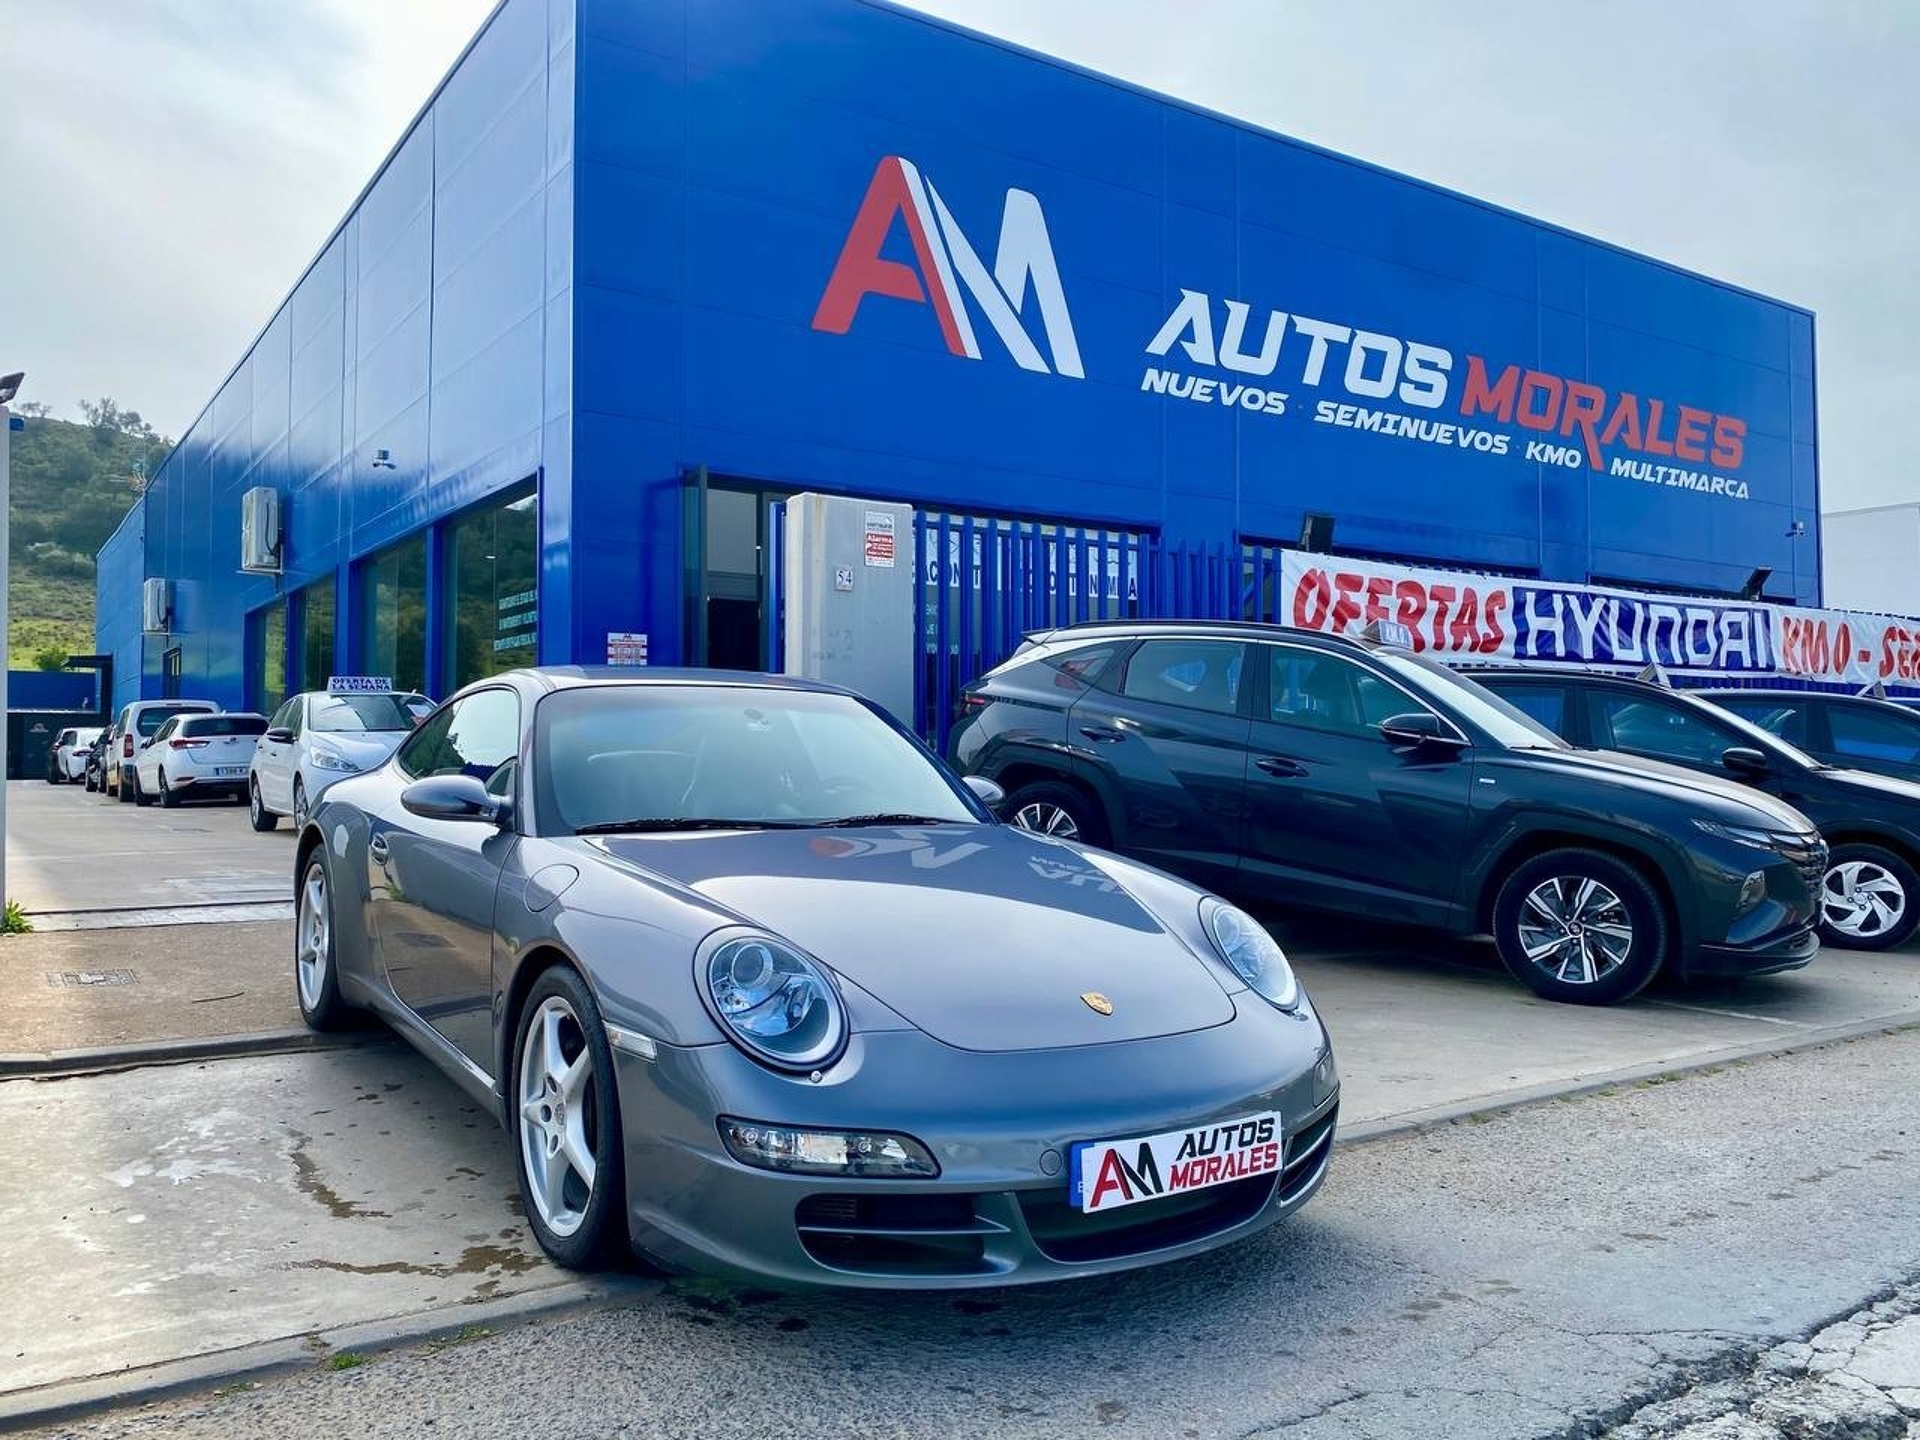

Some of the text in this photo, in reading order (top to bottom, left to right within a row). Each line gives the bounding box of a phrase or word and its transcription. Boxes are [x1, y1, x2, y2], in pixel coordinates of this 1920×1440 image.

[811, 156, 1085, 378] AM
[1145, 288, 1748, 470] AUTOS MORALES
[1141, 368, 1289, 415] NUEVOS
[1314, 400, 1511, 455] SEMINUEVOS
[1610, 457, 1750, 500] MULTIMARCA
[838, 570, 852, 586] 54
[1293, 568, 1507, 653] OFERTAS
[1525, 592, 1767, 669] HYUNDAI
[1090, 1142, 1164, 1208] AM
[1169, 1142, 1279, 1191] MORALES
[1176, 1117, 1275, 1161] AUTOS
